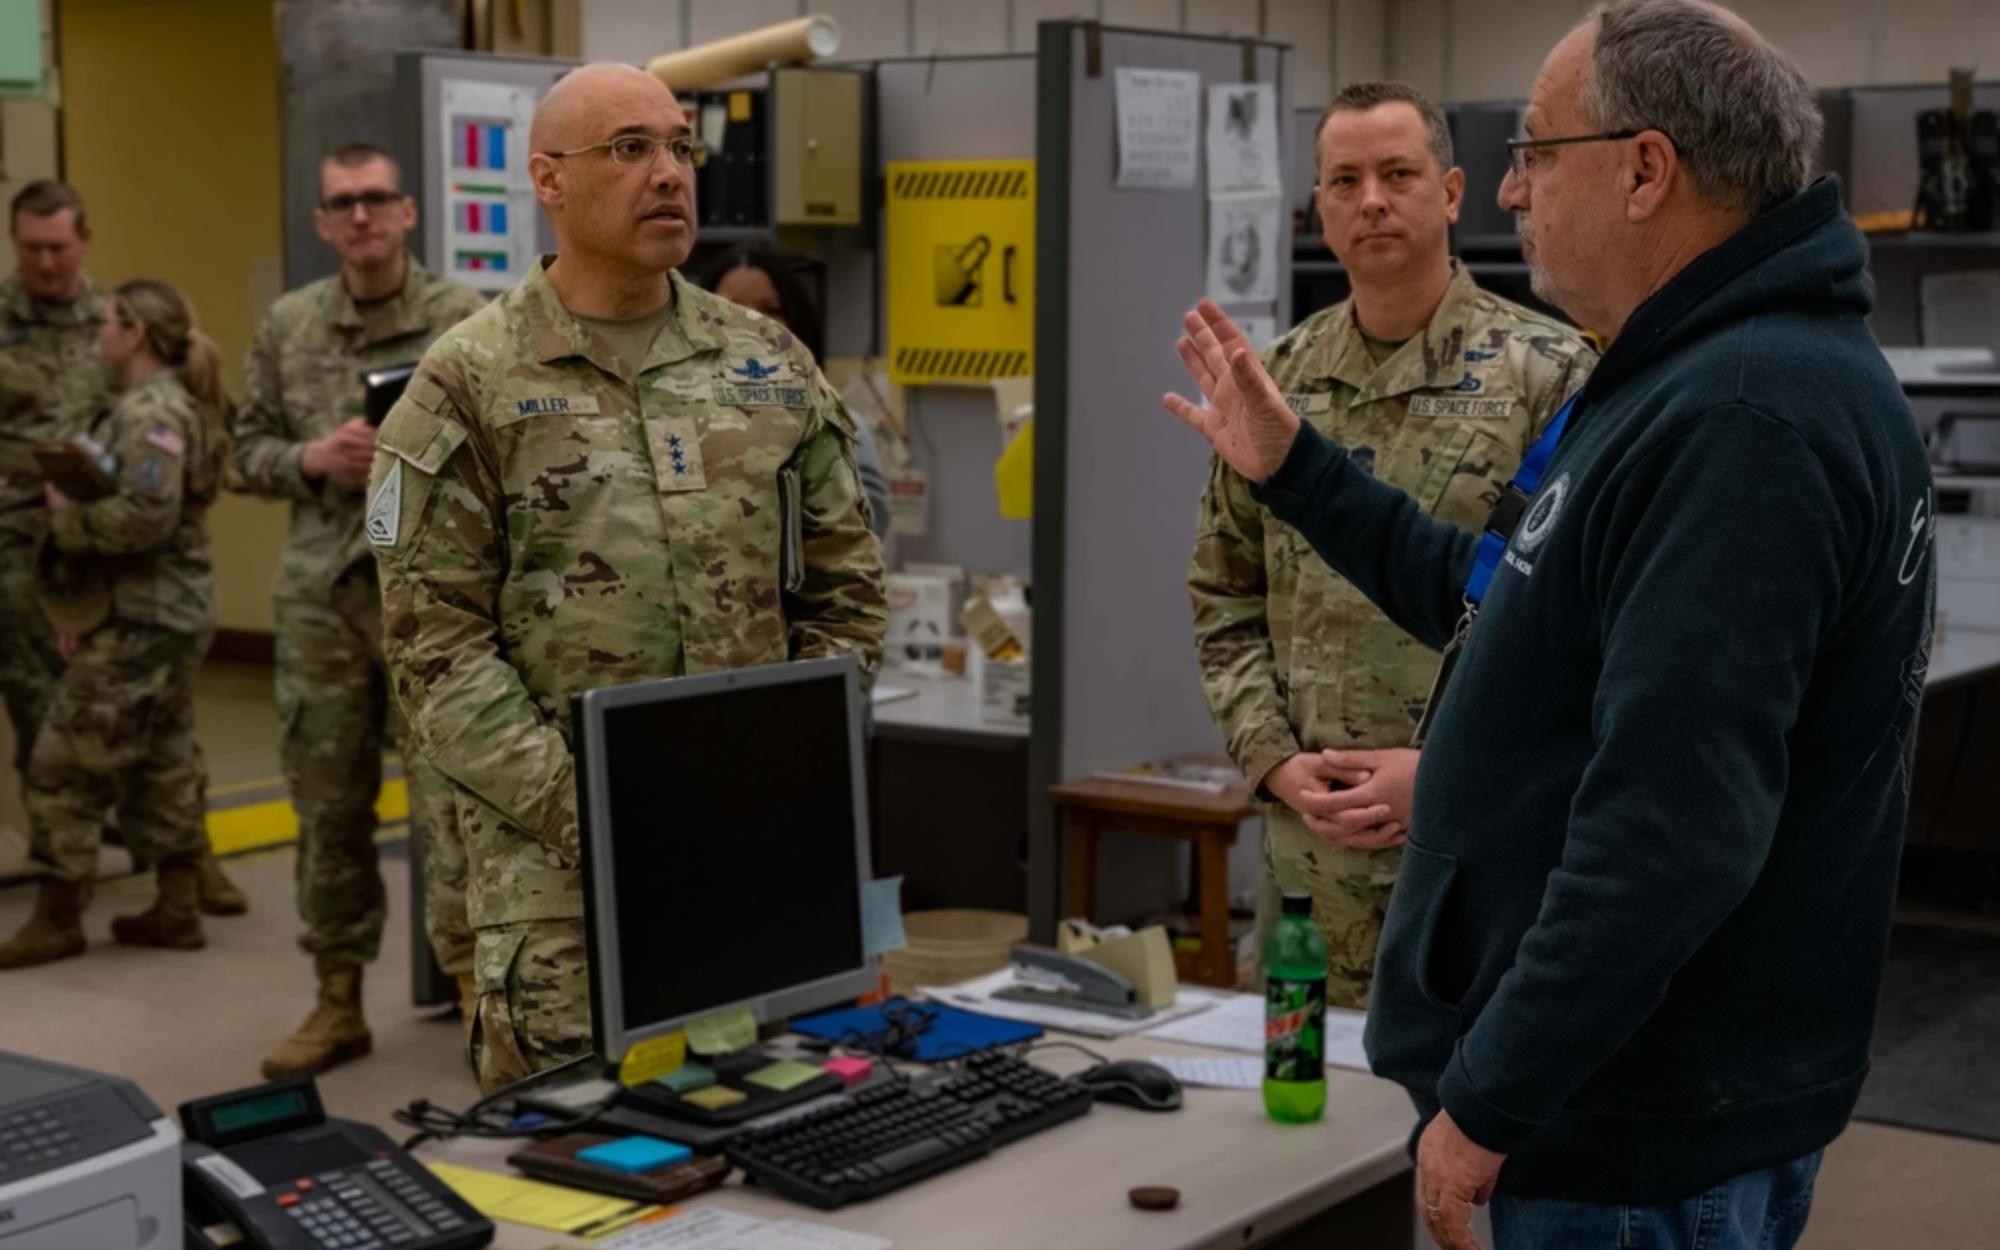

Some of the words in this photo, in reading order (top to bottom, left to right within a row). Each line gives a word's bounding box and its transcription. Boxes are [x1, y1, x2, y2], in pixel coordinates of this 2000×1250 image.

[517, 397, 570, 415] MILLER
[1433, 399, 1471, 415] SPACE
[1471, 400, 1509, 416] FORCE
